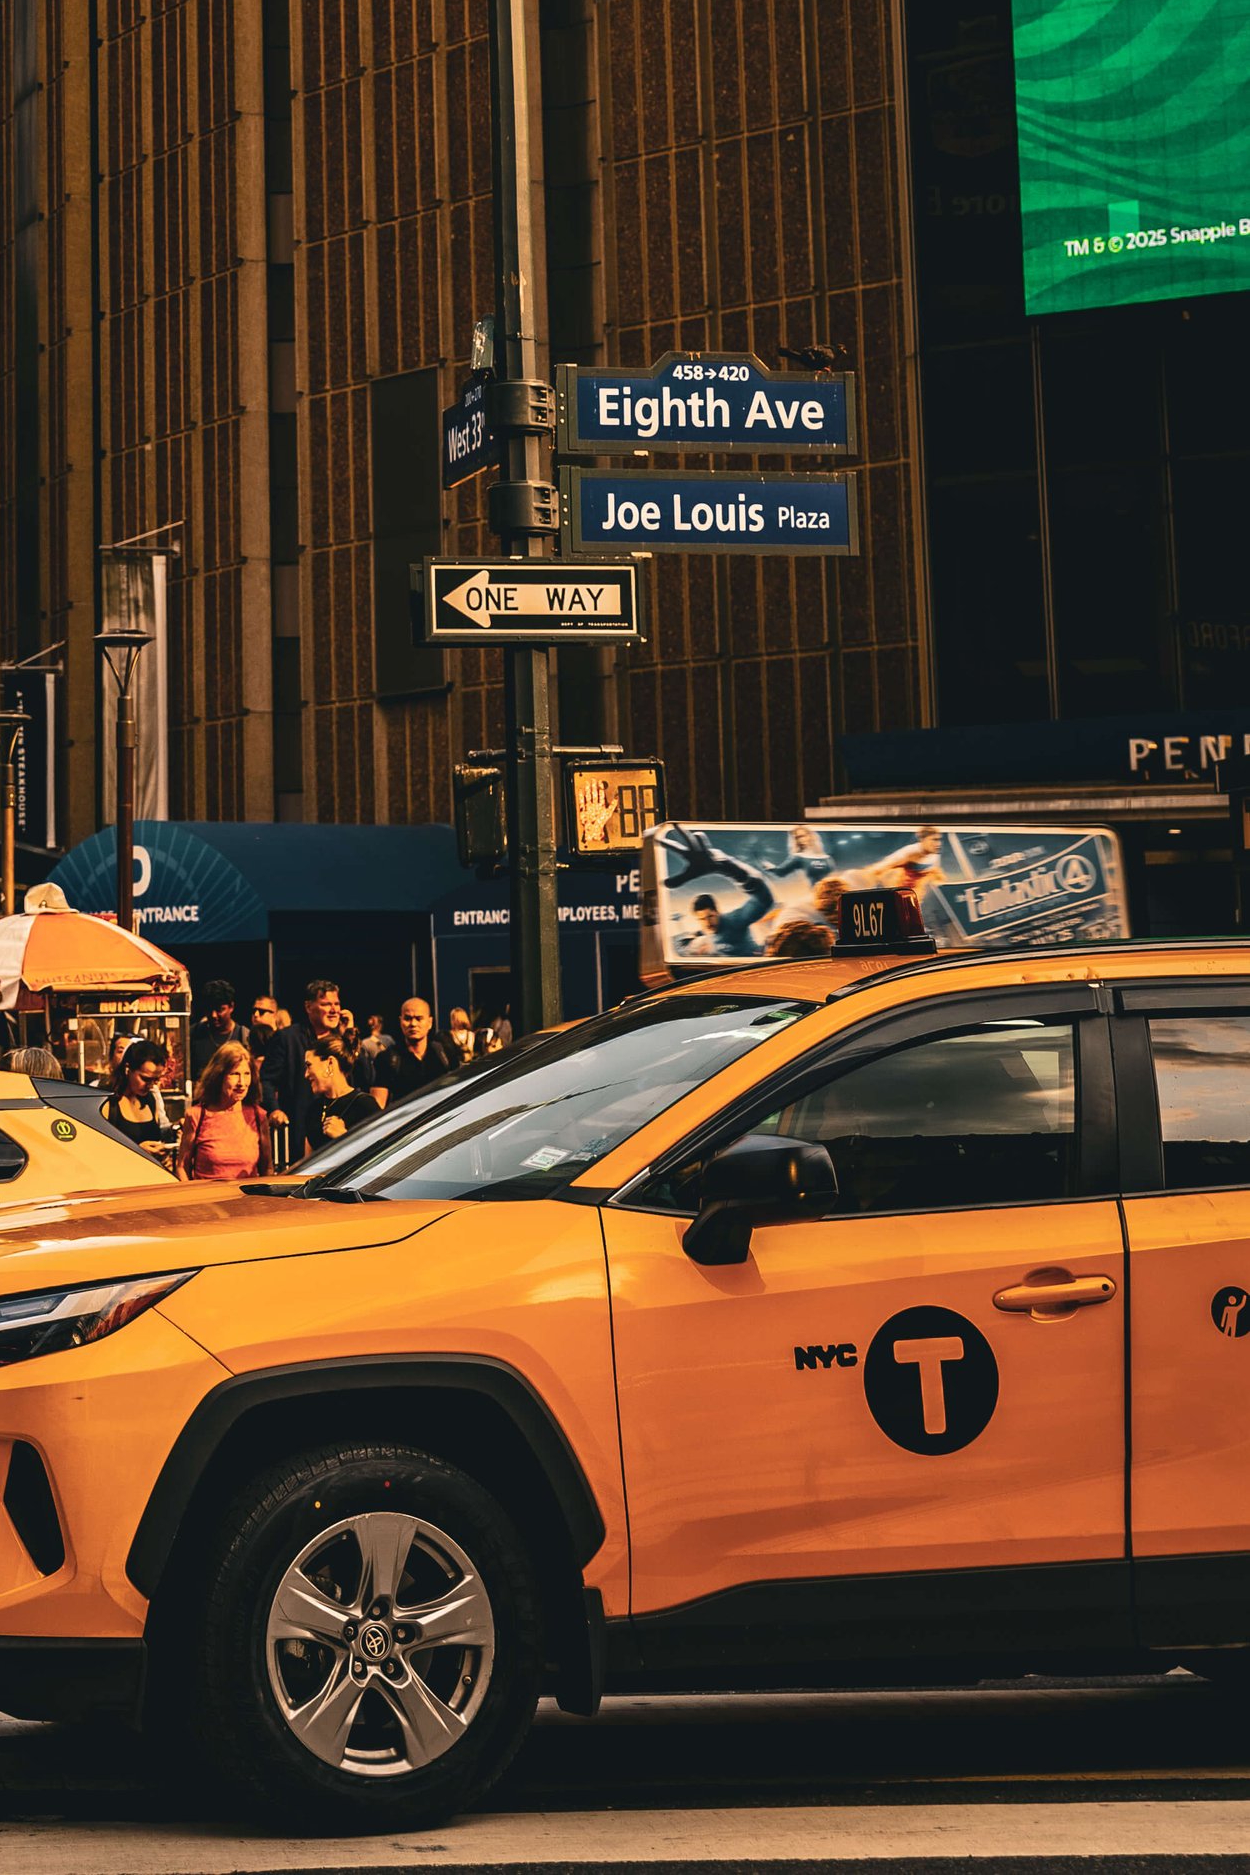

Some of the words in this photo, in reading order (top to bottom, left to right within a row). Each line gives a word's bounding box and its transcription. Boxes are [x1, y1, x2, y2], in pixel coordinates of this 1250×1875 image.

[1064, 238, 1089, 257] TM
[1126, 229, 1167, 250] 2025
[1170, 221, 1236, 244] Snapple
[672, 365, 703, 381] 458
[718, 365, 749, 382] 420
[599, 386, 730, 437] Eighth
[744, 390, 825, 430] Ave
[448, 422, 470, 463] West
[602, 493, 661, 530] Joe
[673, 493, 765, 532] Louis
[778, 506, 830, 529] Plaza
[466, 587, 519, 611] ONE
[546, 587, 604, 611] WAY
[1129, 734, 1250, 771] PEN
[453, 909, 510, 926] ENTRANC
[853, 902, 884, 937] 9L67
[794, 1342, 858, 1371] NYC
[893, 1336, 965, 1435] T
